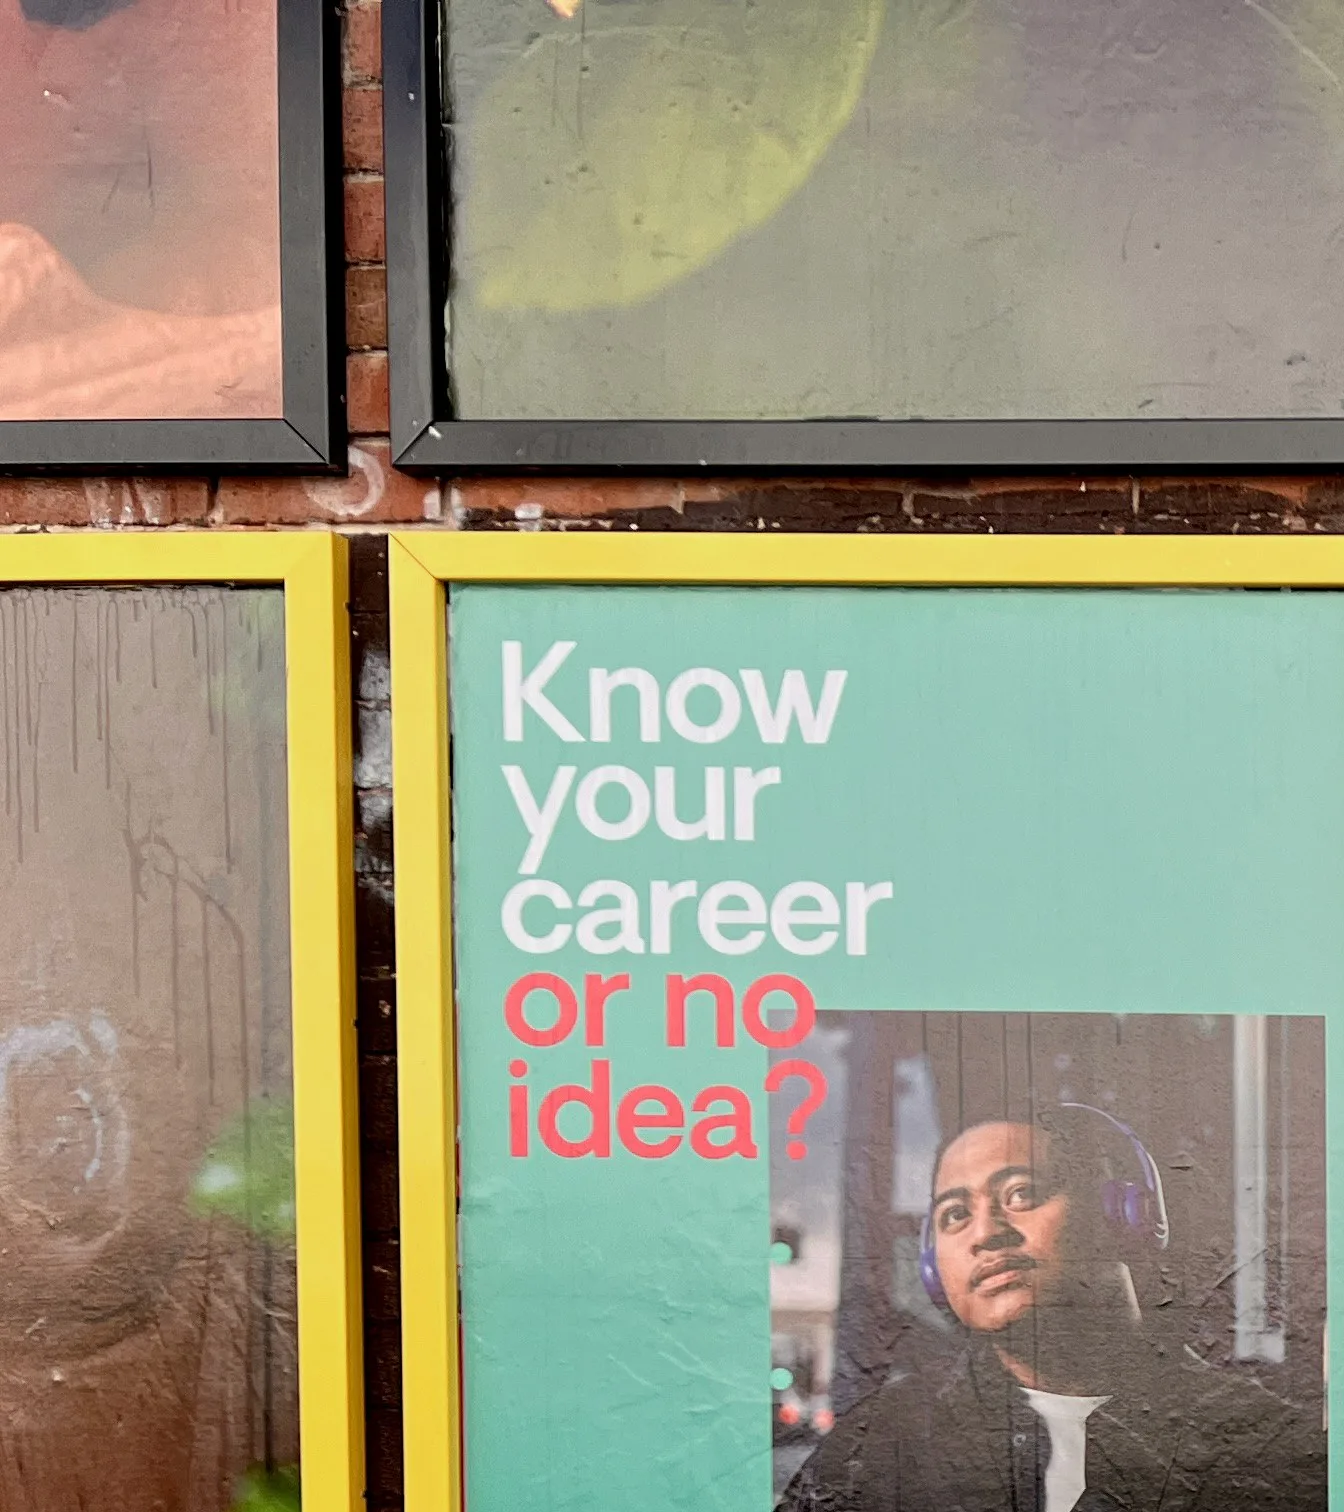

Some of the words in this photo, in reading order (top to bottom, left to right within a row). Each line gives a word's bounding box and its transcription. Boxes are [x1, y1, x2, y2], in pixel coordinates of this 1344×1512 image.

[501, 639, 848, 746] Know
[501, 764, 782, 875] your
[501, 878, 893, 956] career
[503, 972, 630, 1048] or
[666, 972, 817, 1050] no
[508, 1059, 829, 1161] idea?
